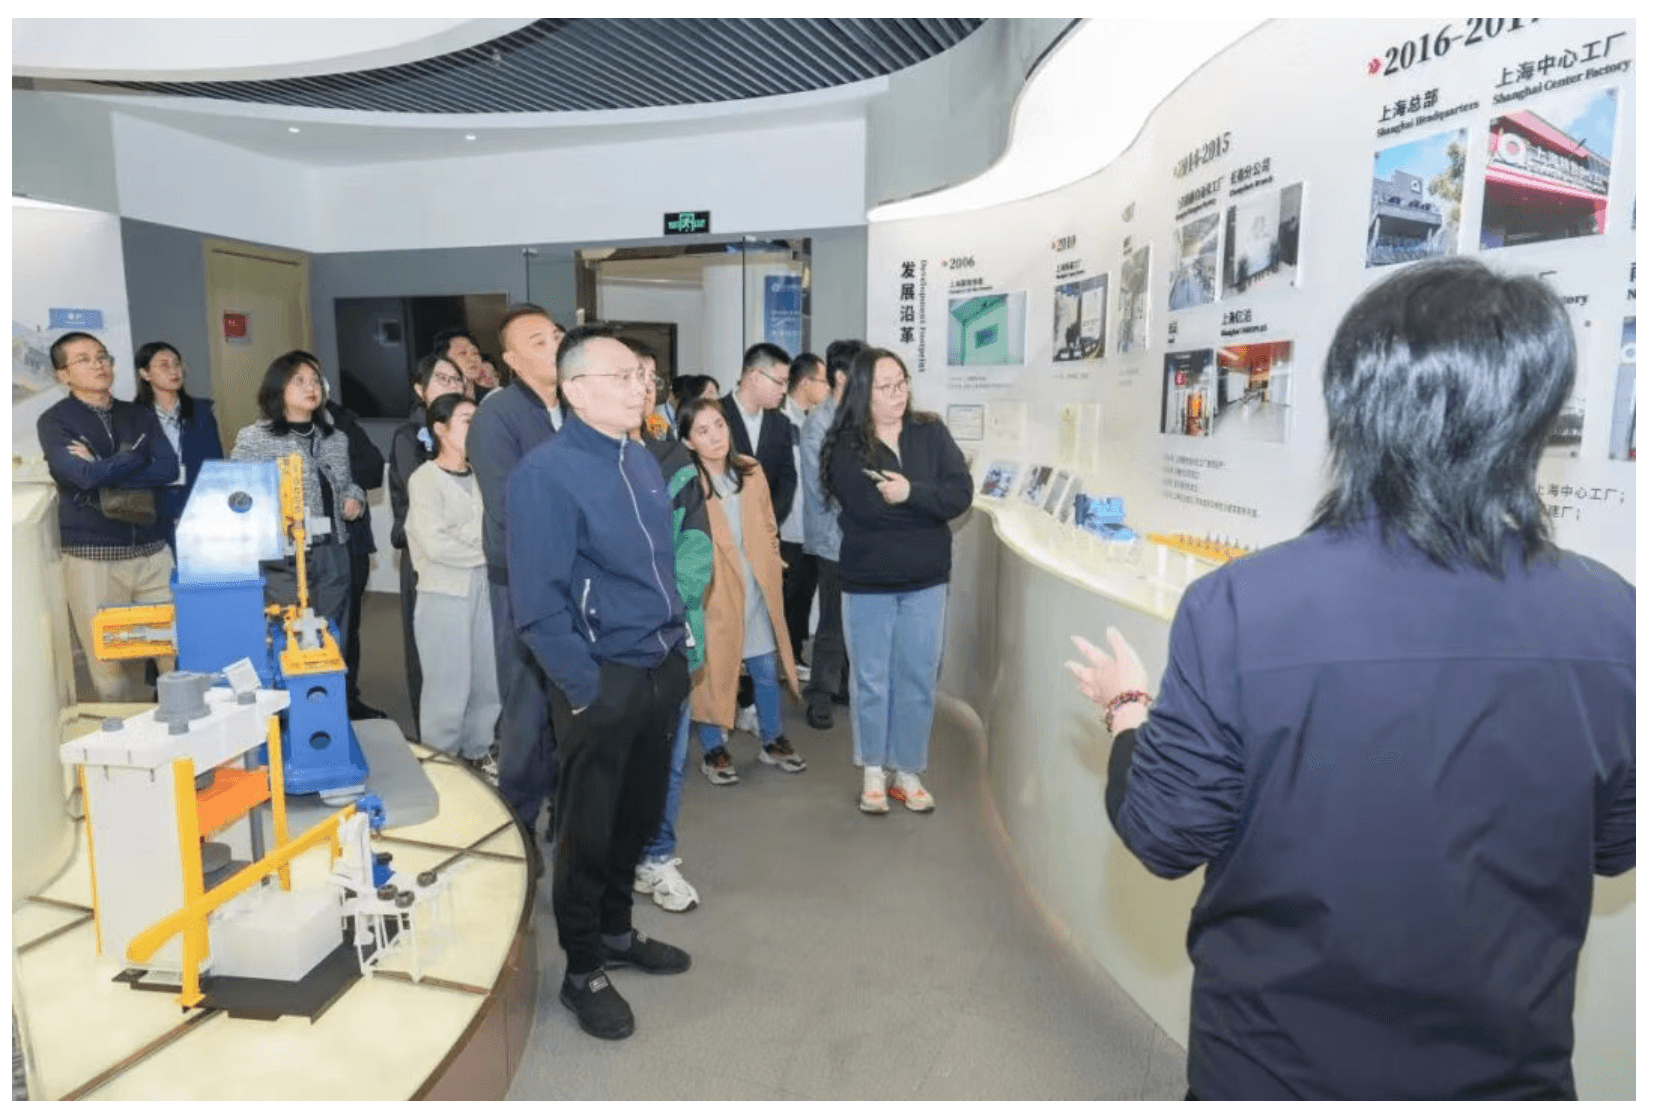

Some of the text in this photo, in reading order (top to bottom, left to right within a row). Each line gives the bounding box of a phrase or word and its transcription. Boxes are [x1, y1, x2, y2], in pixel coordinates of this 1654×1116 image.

[1383, 18, 1540, 76] 2016-20
[1495, 31, 1627, 88] 上海中心工厂
[1378, 88, 1440, 122] 上海总部
[1492, 59, 1632, 105] Shanghai Center Factory
[1416, 101, 1480, 126] Headquarters
[949, 255, 975, 270] 2006
[900, 260, 916, 344] 发展沿革
[919, 259, 927, 324] Development
